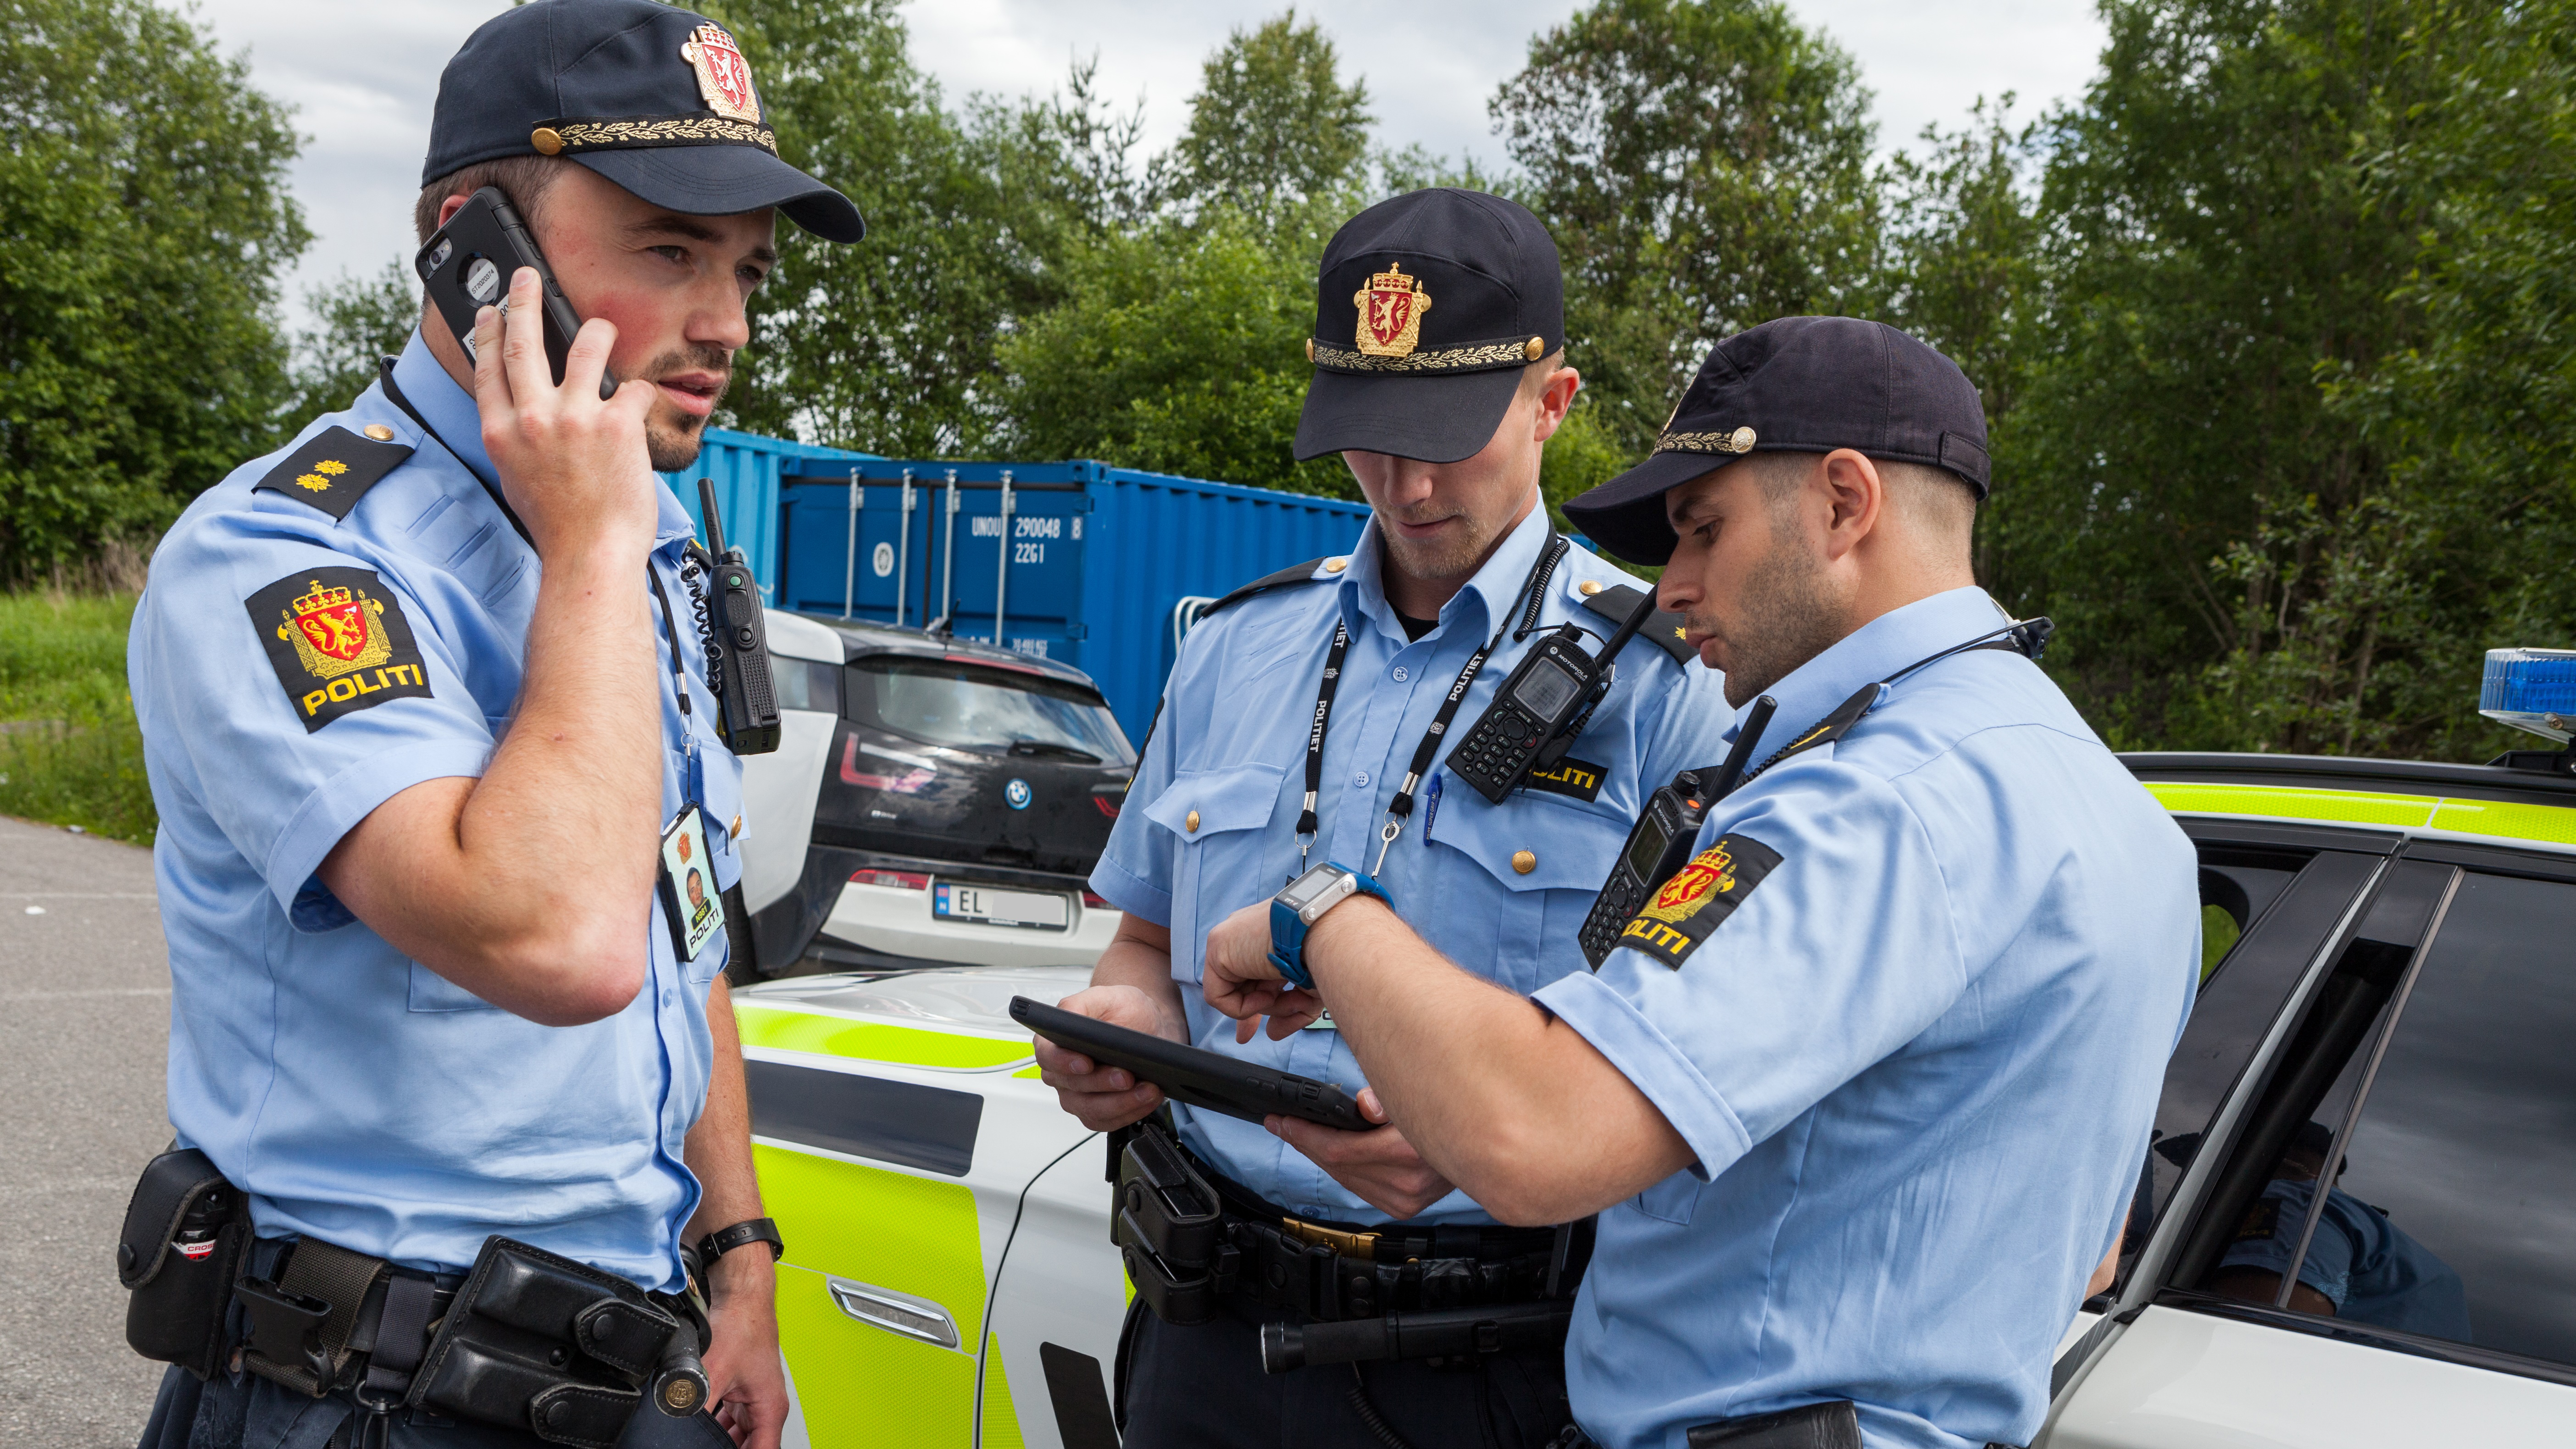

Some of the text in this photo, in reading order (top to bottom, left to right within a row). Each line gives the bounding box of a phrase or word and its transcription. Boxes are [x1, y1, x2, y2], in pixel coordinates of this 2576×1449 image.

[472, 269, 494, 294] ST2020374
[708, 513, 717, 536] GPS
[972, 516, 1081, 539] UNOU 290048 8
[1015, 543, 1044, 564] 22G1
[1449, 654, 1483, 701] POLITIET
[1558, 655, 1588, 679] MOTOROLA
[303, 664, 423, 716] POLITI
[1310, 700, 1327, 752] POLITIET
[1658, 808, 1674, 833] MOTOROLA
[695, 905, 707, 923] N981
[960, 890, 983, 913] EL
[689, 908, 719, 949] POLITI
[1622, 920, 1690, 955] OLITI
